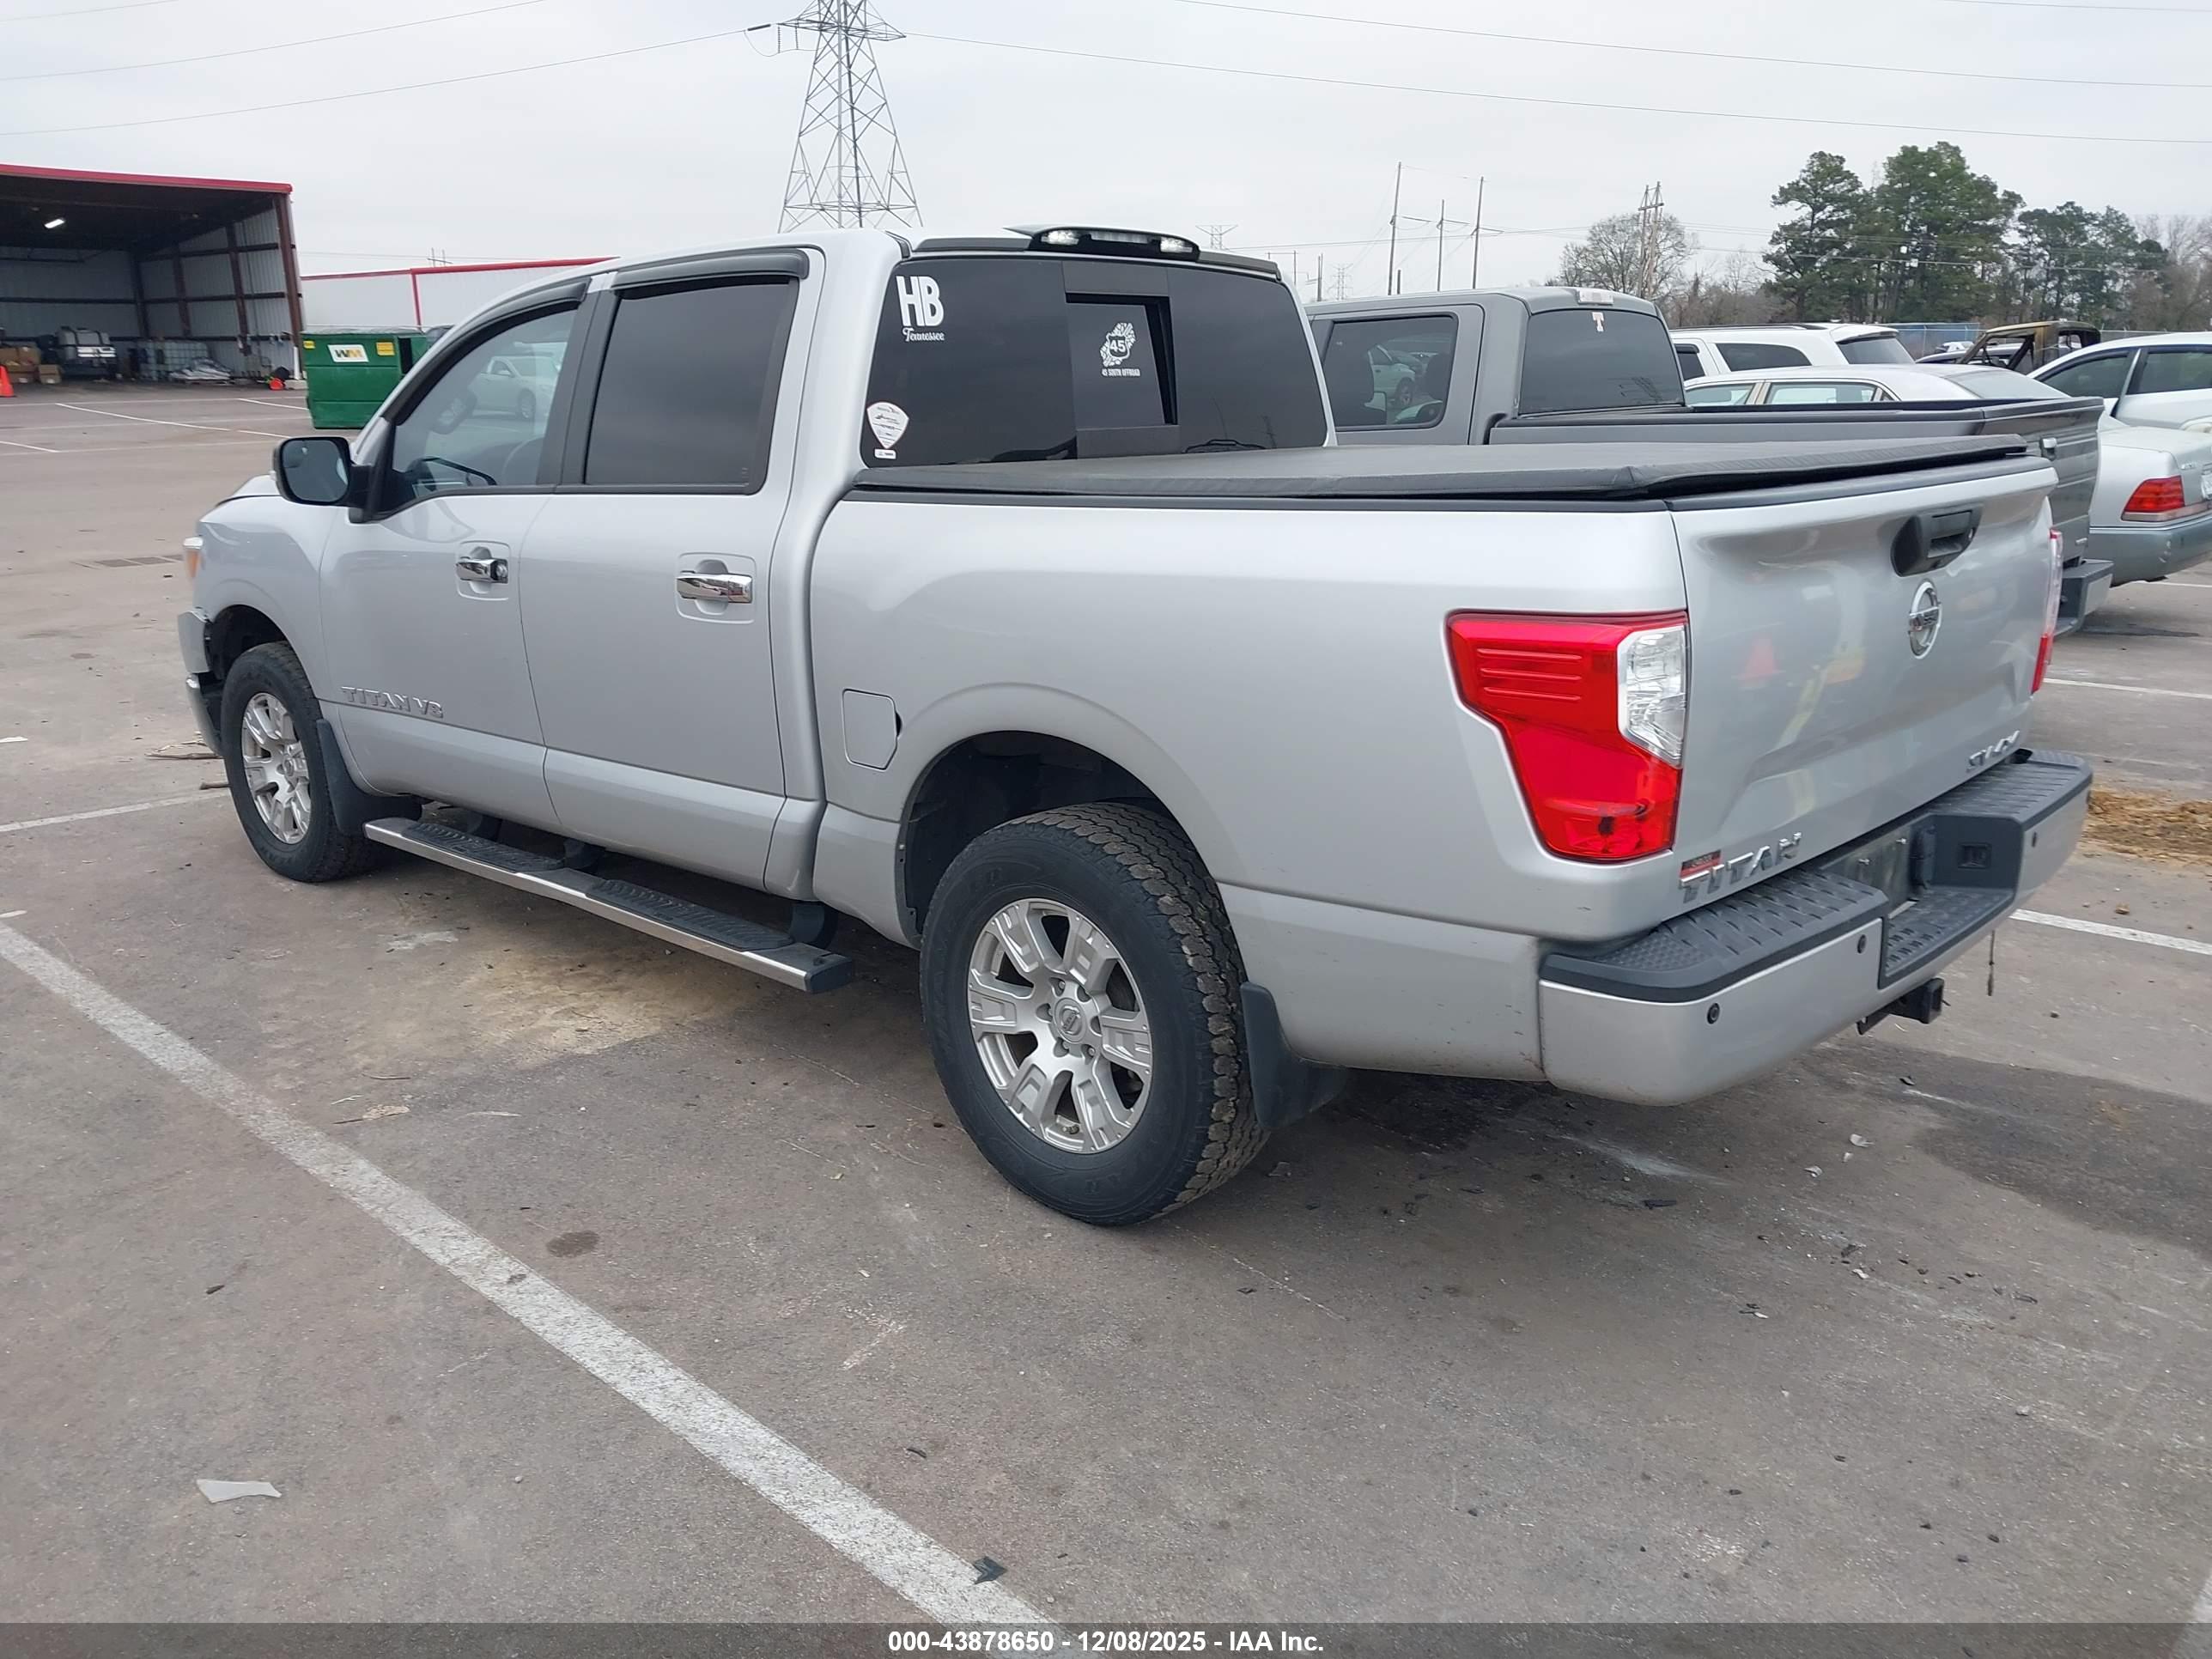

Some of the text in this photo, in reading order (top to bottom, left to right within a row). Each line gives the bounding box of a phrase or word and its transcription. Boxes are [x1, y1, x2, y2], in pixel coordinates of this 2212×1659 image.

[896, 276, 944, 326] HB
[902, 327, 945, 342] Tennessee
[1110, 339, 1127, 352] 45
[333, 349, 363, 358] WM
[341, 686, 410, 712] TITAN
